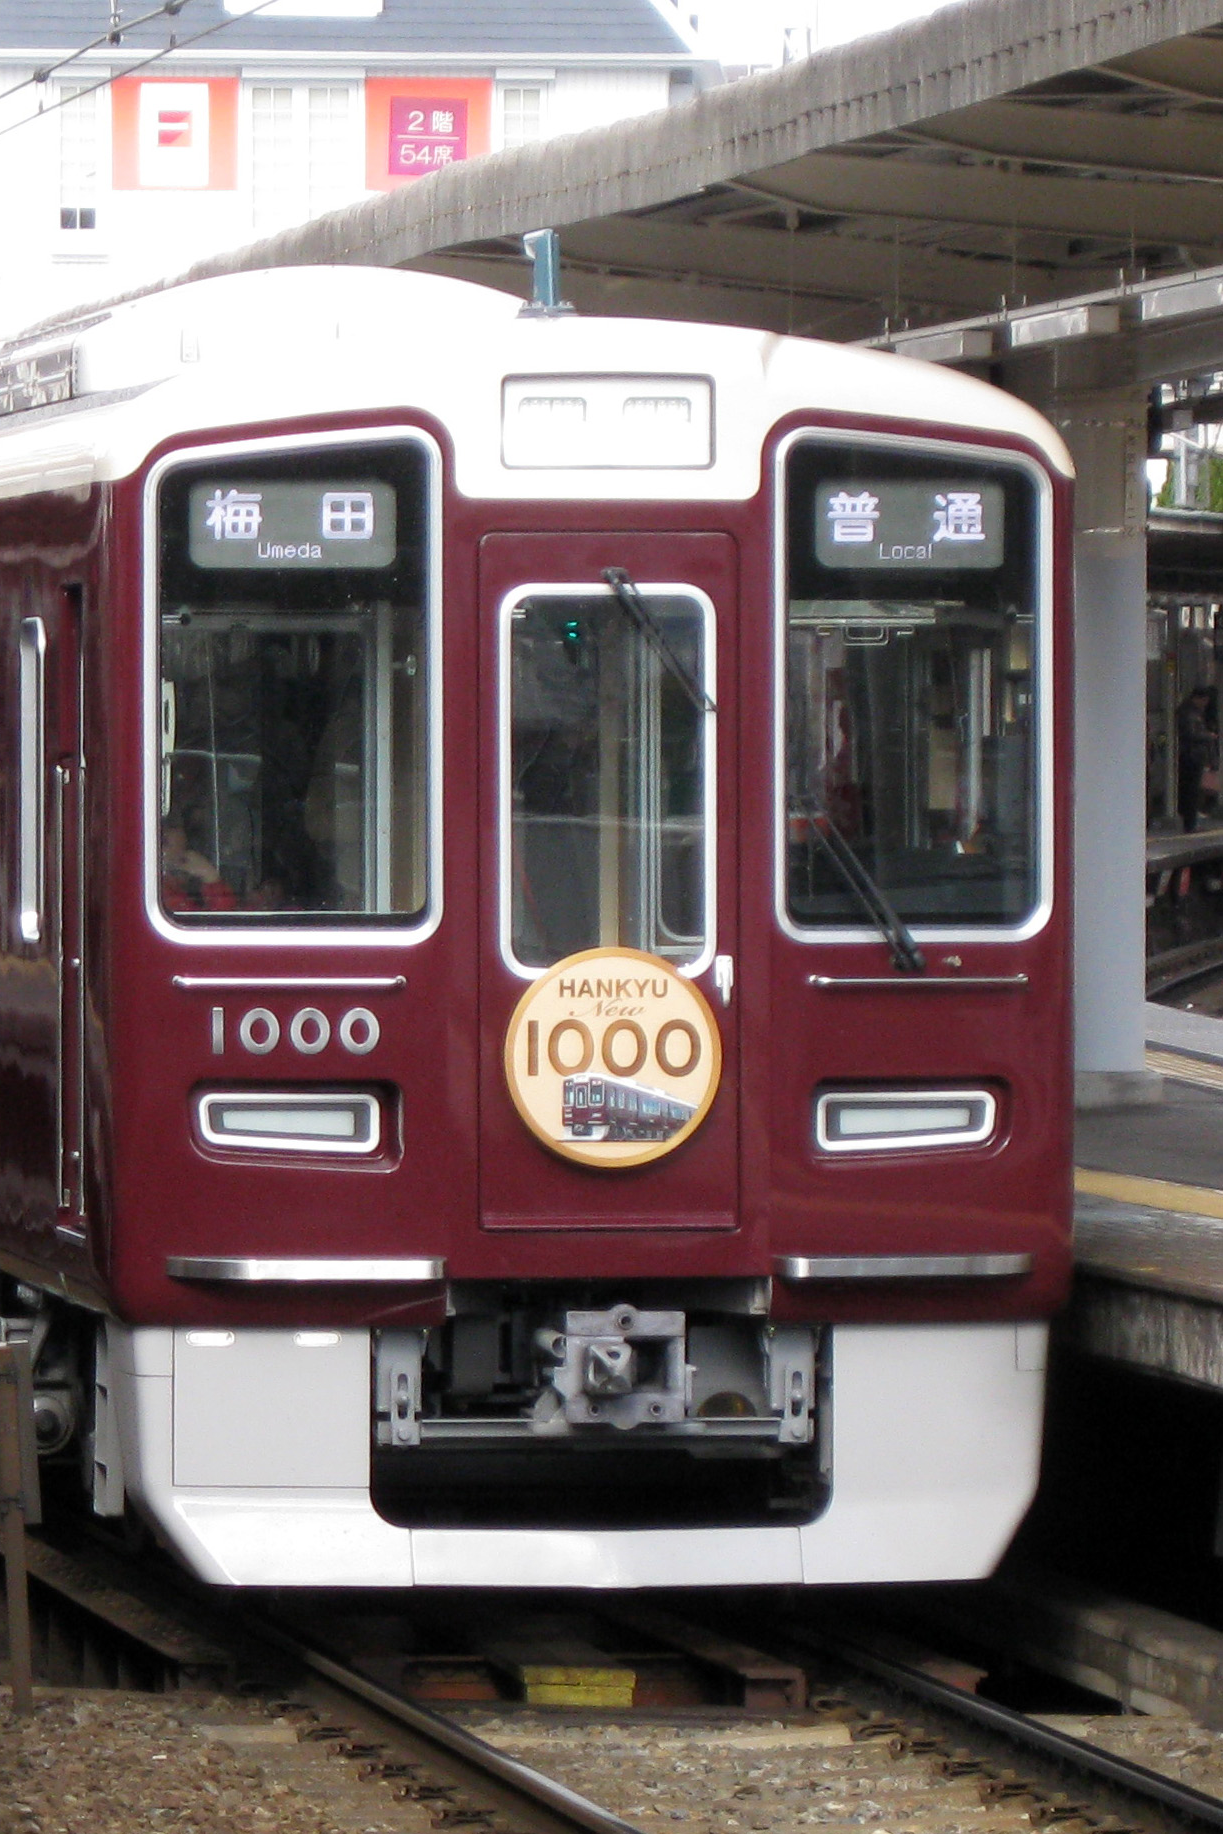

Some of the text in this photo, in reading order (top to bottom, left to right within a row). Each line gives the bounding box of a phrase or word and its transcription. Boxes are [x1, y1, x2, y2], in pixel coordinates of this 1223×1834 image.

[408, 110, 454, 133] 2階
[400, 144, 454, 166] 54席
[205, 489, 374, 540] 梅田
[828, 491, 986, 543] 普通
[257, 542, 323, 559] Umeda
[879, 542, 933, 560] Local
[559, 978, 669, 999] HANKYU
[568, 999, 646, 1018] New
[212, 1006, 381, 1055] 1000
[527, 1018, 702, 1078] 1000
